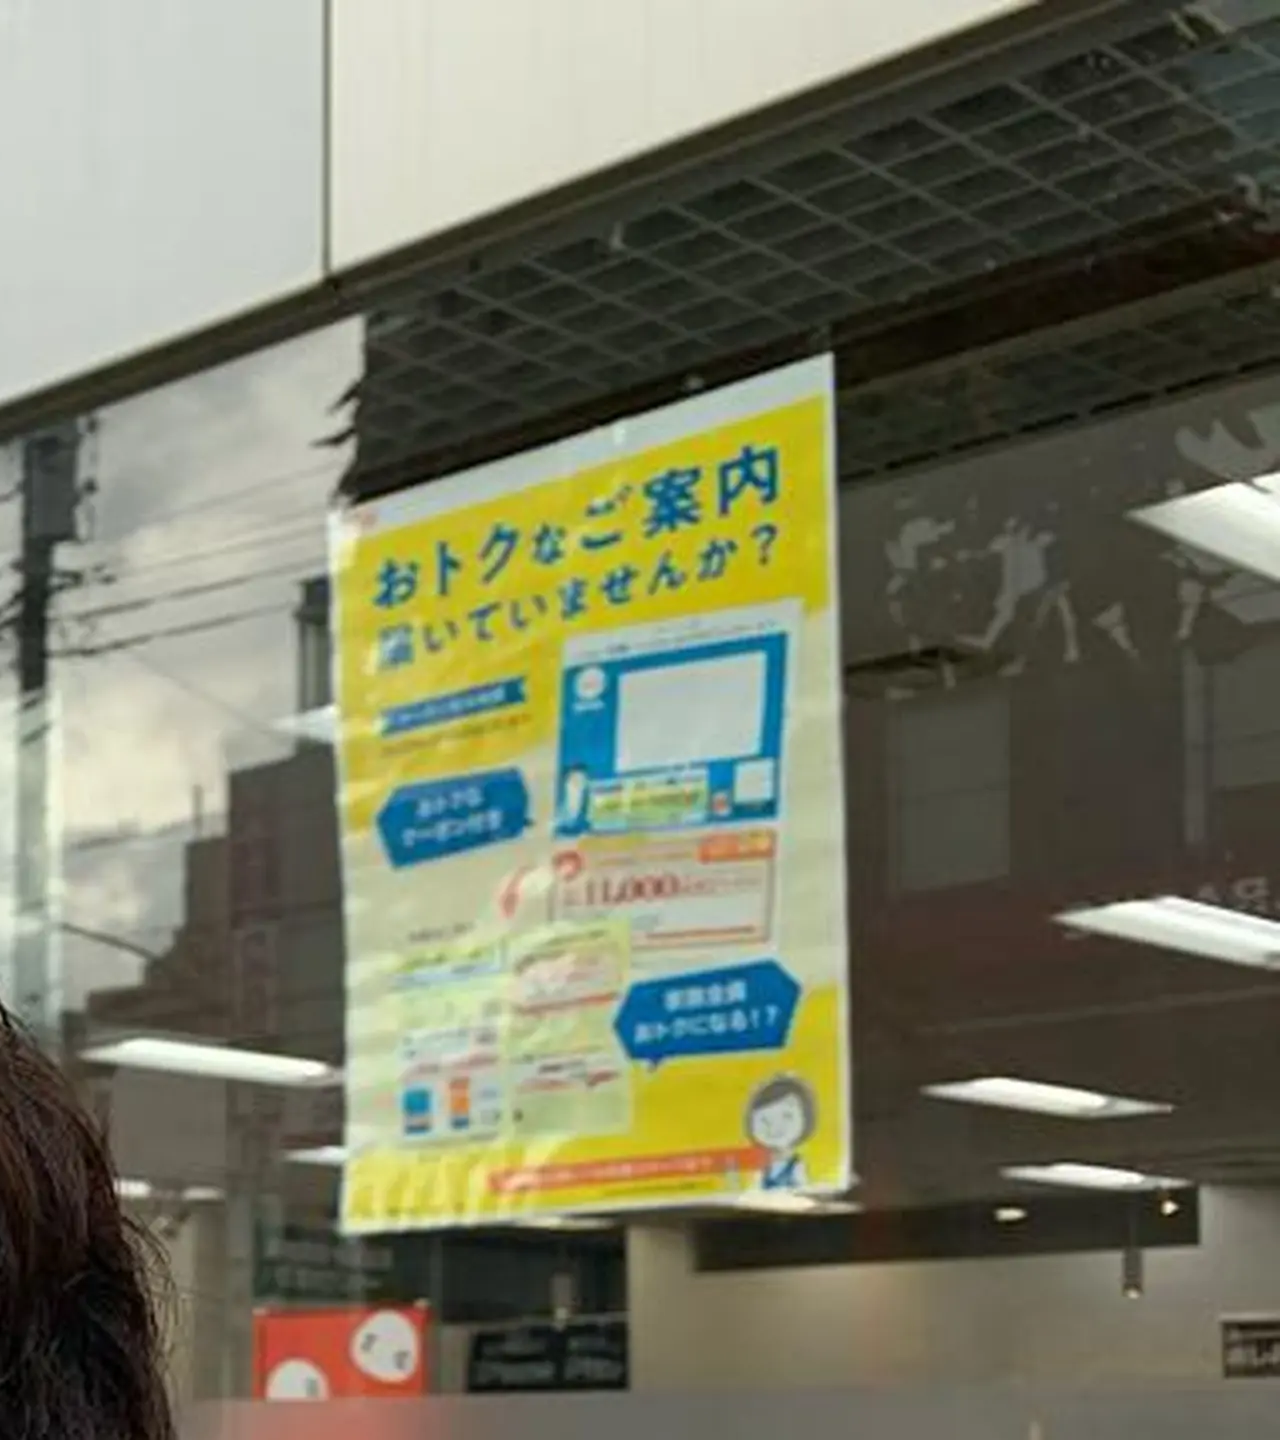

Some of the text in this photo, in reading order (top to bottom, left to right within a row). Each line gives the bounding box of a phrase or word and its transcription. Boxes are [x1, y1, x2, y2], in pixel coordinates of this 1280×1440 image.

[373, 445, 779, 608] おトクなご案内
